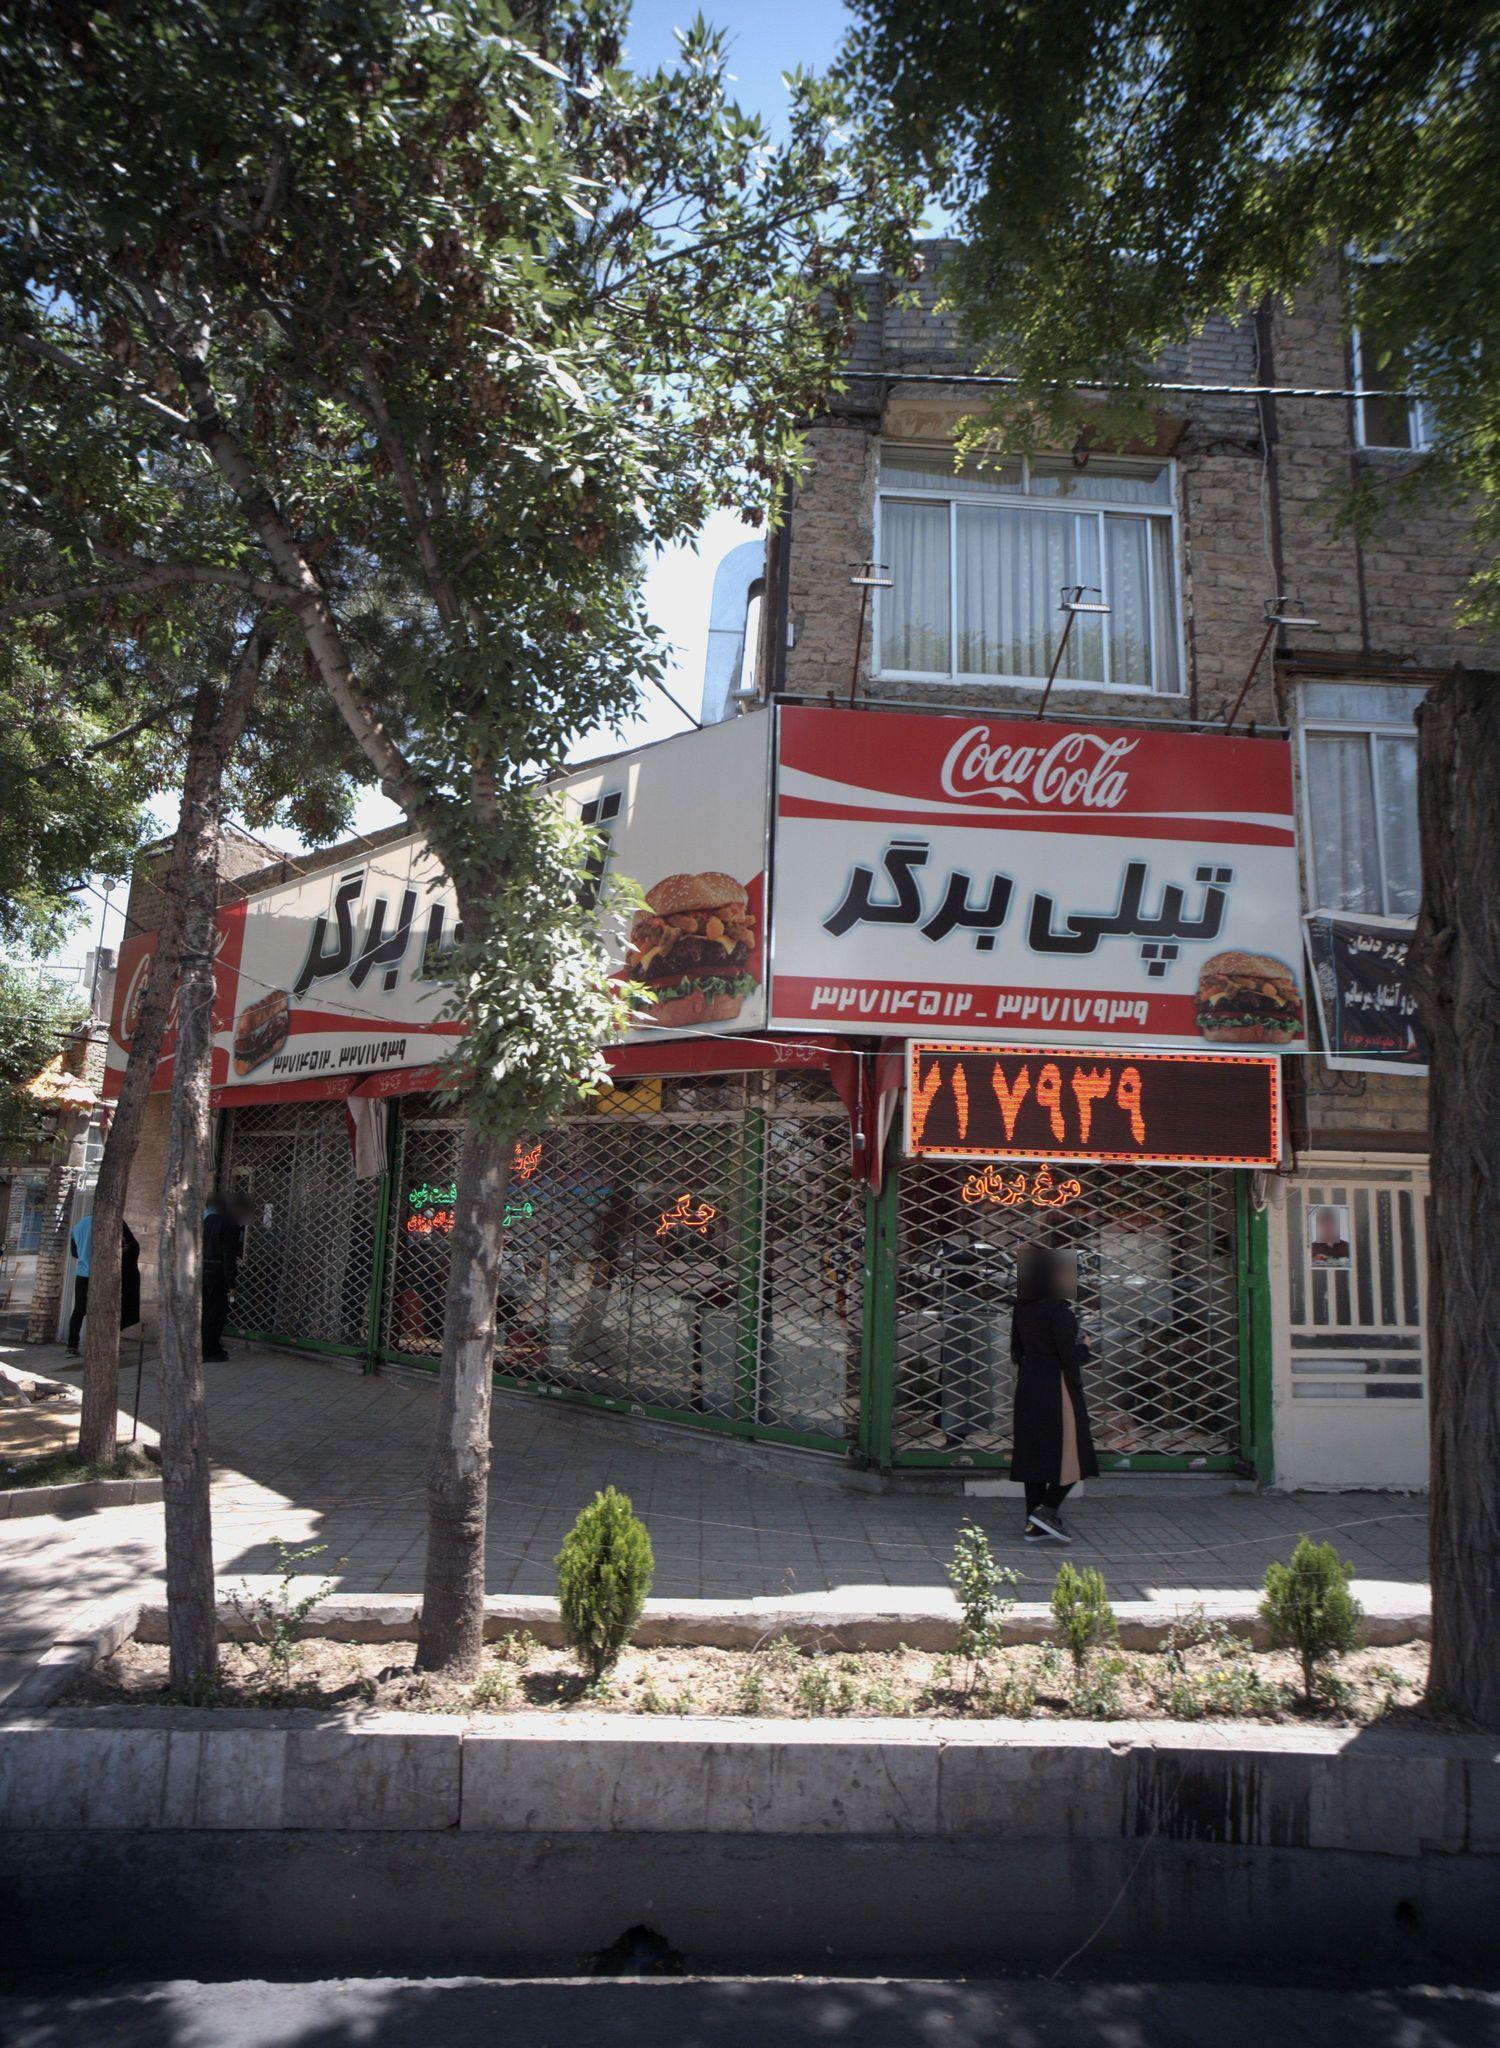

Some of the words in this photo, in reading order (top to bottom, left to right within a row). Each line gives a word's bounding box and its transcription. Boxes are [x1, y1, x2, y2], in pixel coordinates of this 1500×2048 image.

[941, 725, 1140, 809] Coca-Cola
[293, 868, 418, 996] برگر
[821, 840, 1014, 952] برگر
[1027, 859, 1233, 977] تپلی
[995, 993, 1149, 1026] ۳۲۷۱۷۹۳۹
[962, 1164, 1026, 1206] بریان
[1031, 1163, 1081, 1207] مرغ
